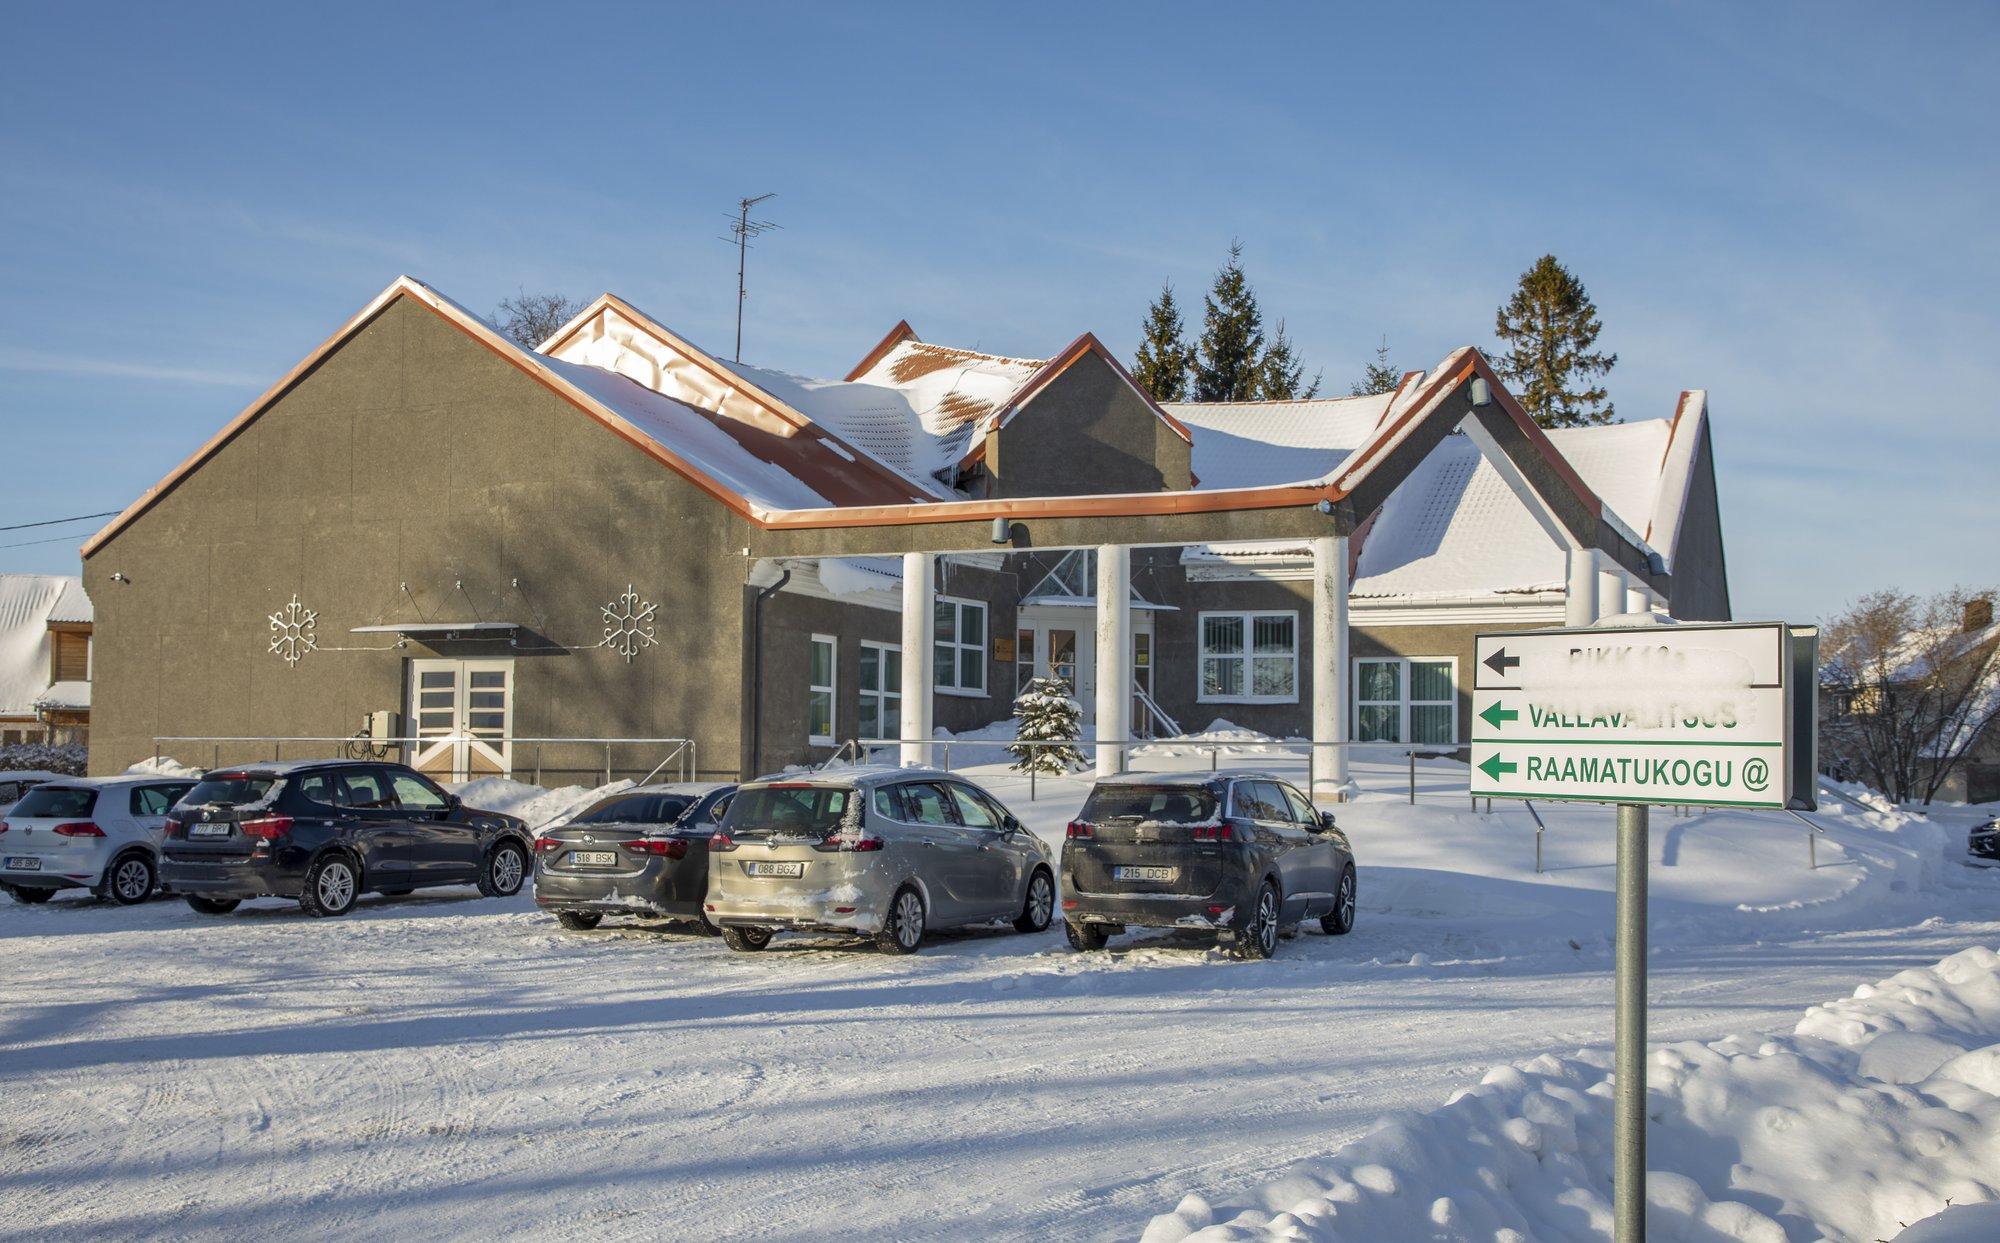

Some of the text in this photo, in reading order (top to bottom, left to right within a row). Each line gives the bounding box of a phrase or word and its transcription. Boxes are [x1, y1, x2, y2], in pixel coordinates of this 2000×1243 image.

[1526, 755, 1770, 792] RAAMATUKOGU @
[576, 853, 613, 863] 518 BSK
[757, 864, 797, 875] 088 BGZ
[1123, 868, 1169, 879] 215 DCB
